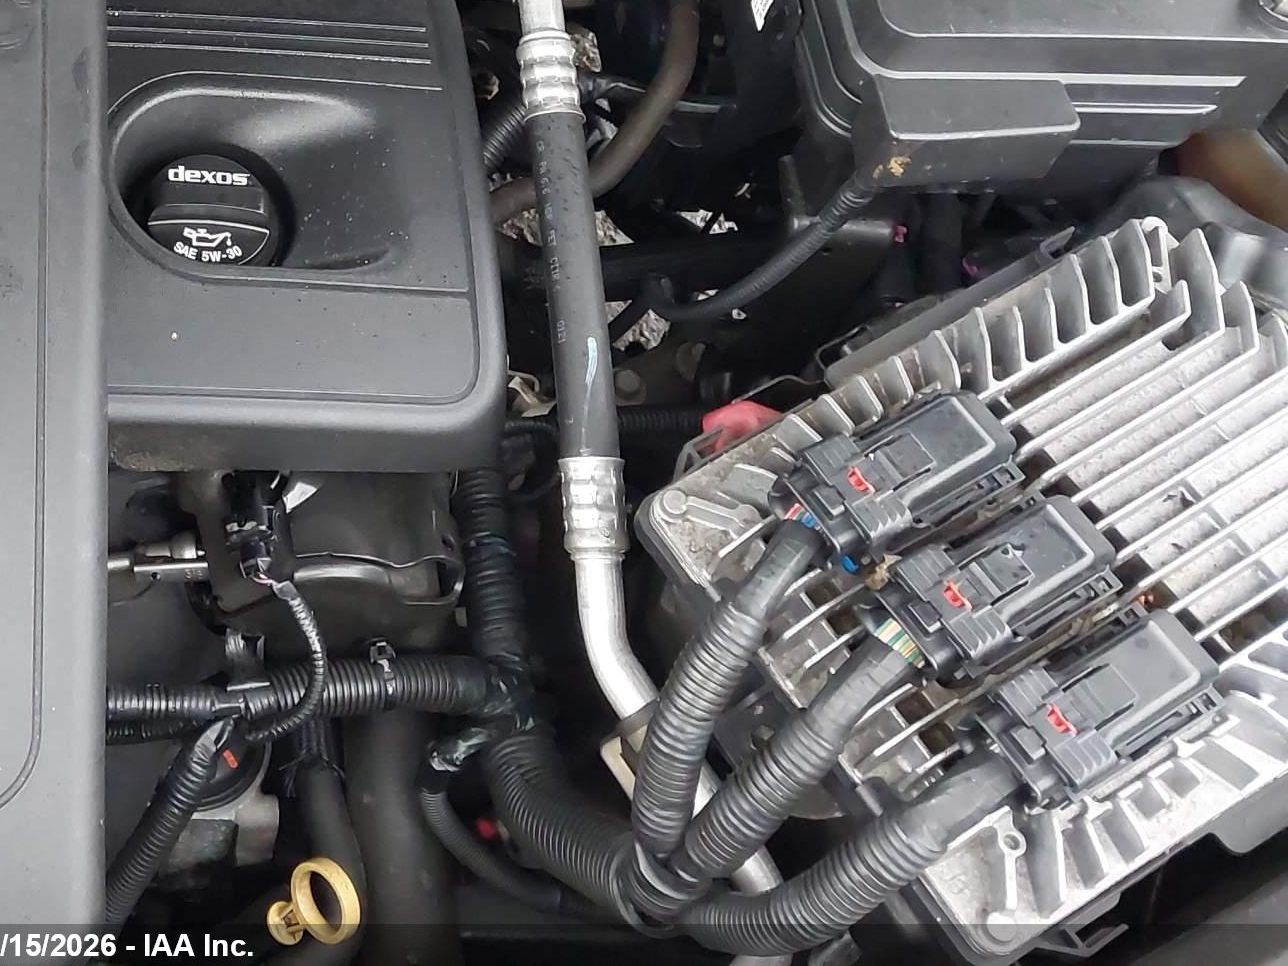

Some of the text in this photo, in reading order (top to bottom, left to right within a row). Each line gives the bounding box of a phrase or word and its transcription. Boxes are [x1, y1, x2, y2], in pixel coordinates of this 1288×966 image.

[168, 166, 251, 186] dexos
[173, 241, 243, 263] SAE 5W-30
